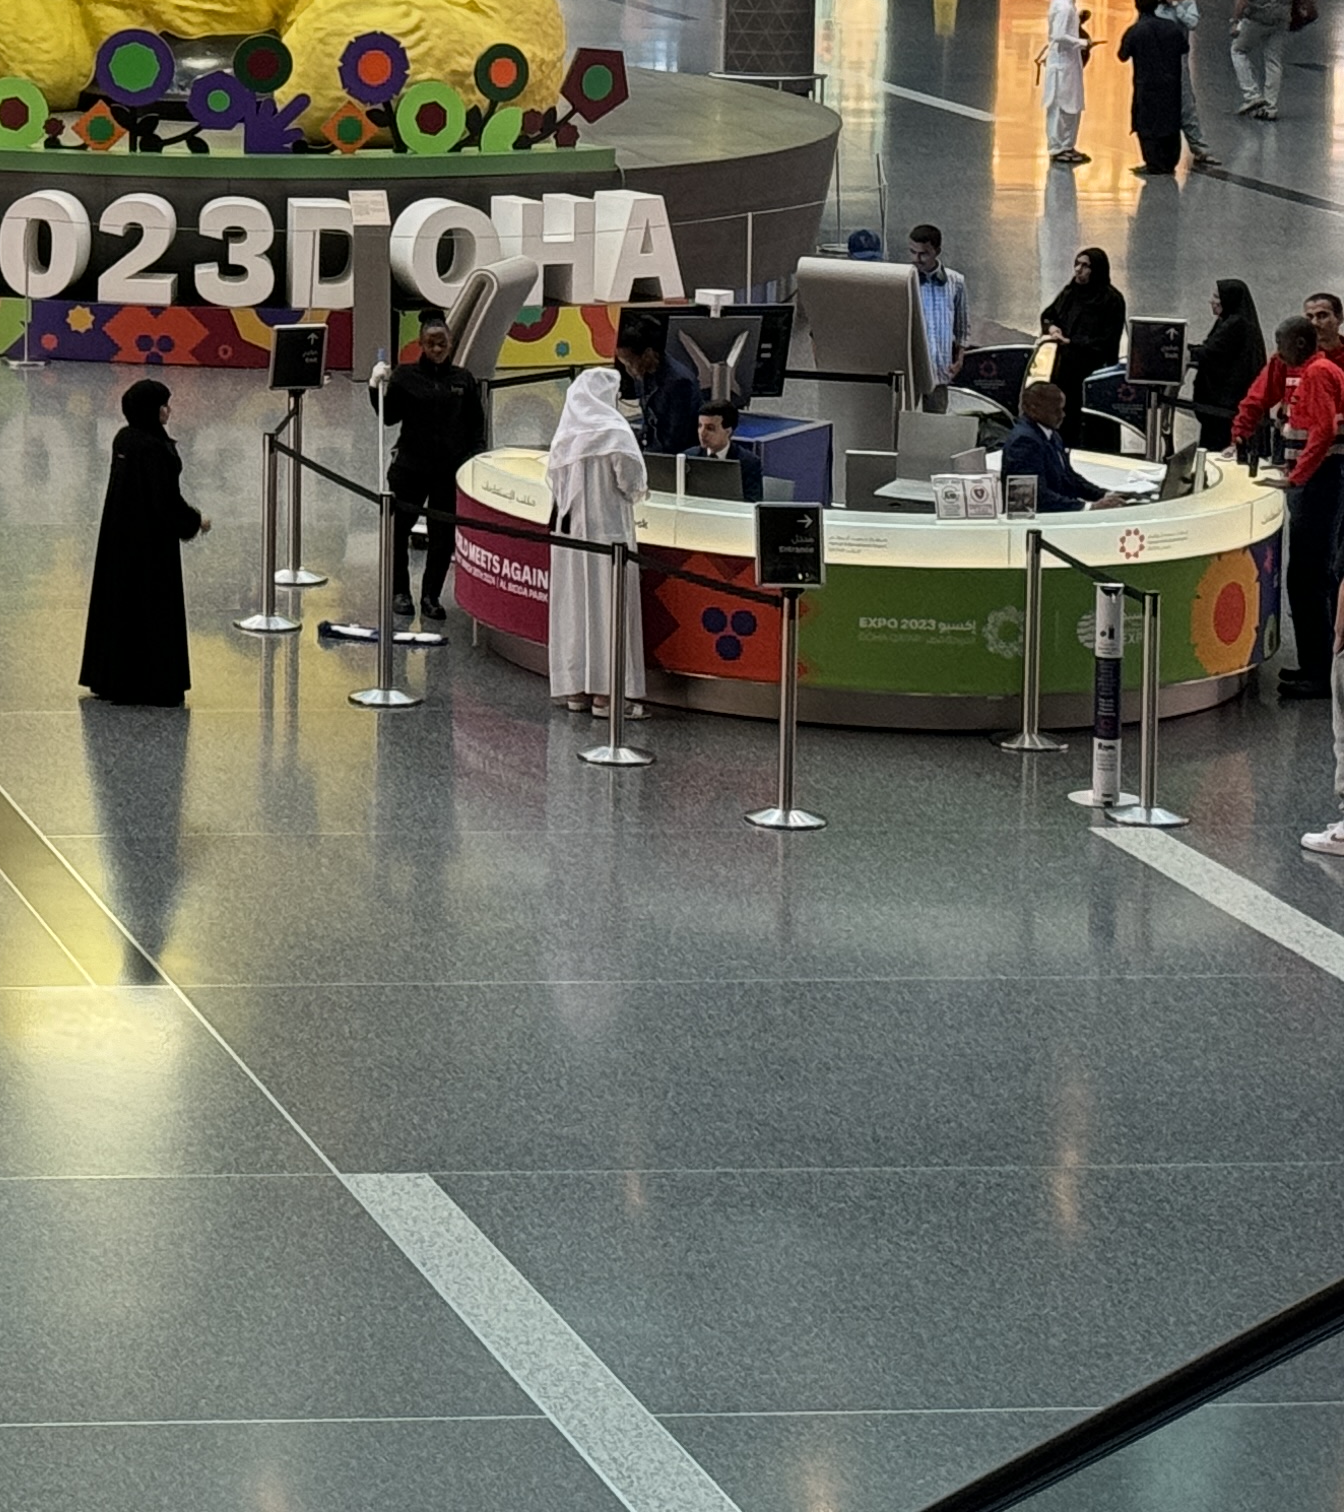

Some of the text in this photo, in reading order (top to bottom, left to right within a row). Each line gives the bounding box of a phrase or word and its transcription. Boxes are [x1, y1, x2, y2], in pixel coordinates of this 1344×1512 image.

[468, 541, 501, 575] MEETS
[501, 557, 549, 590] AGAIN
[859, 616, 937, 631] EXPO 2023
